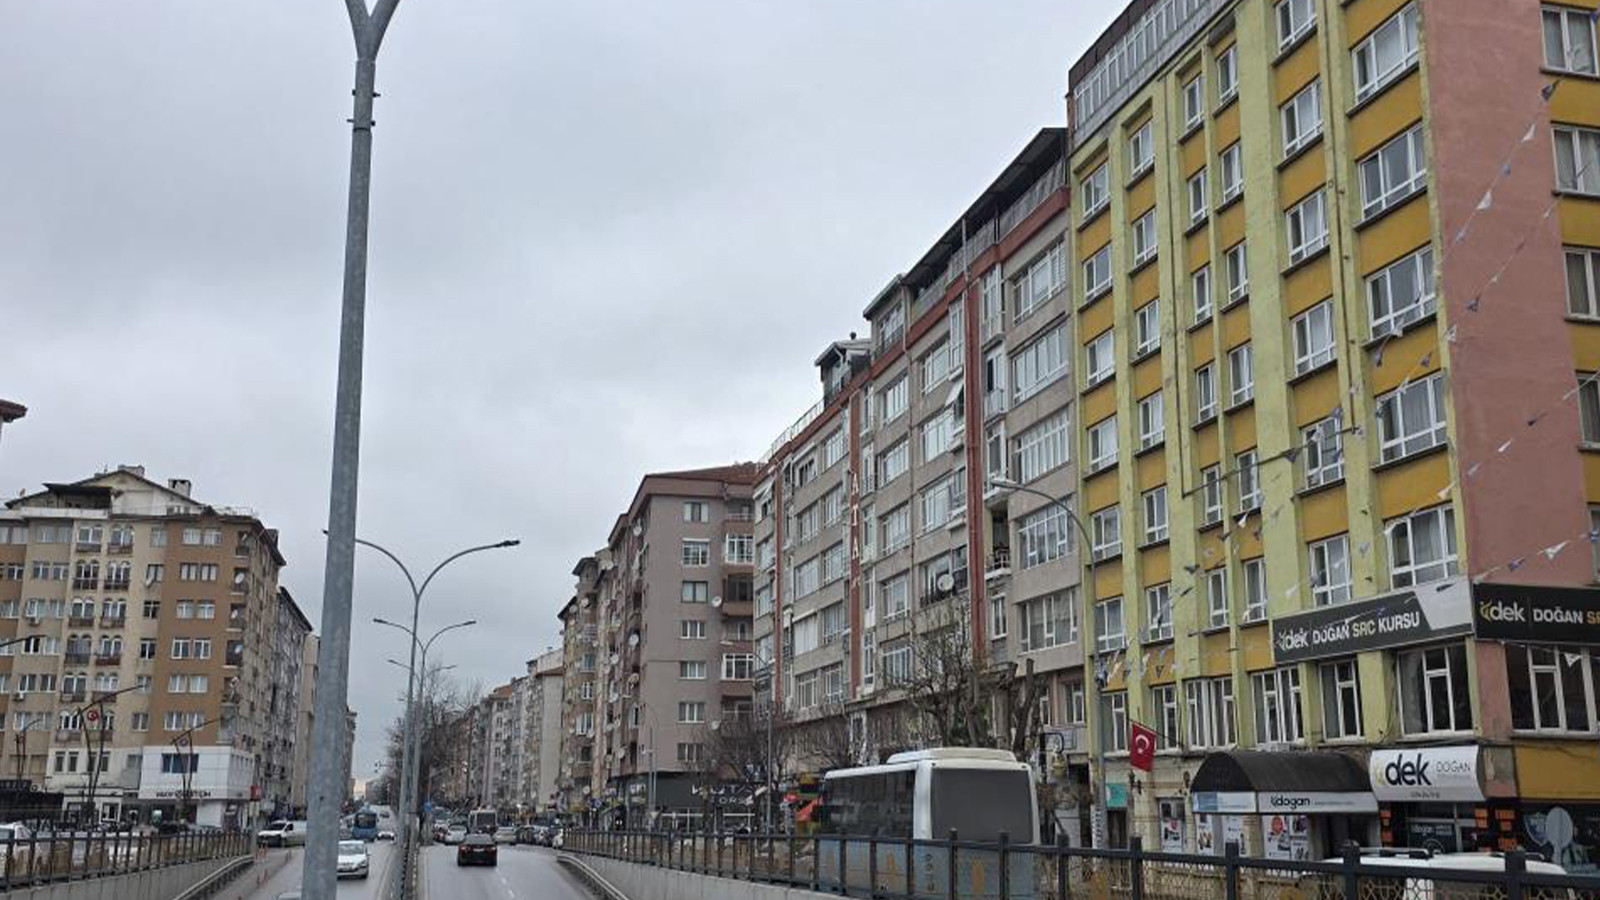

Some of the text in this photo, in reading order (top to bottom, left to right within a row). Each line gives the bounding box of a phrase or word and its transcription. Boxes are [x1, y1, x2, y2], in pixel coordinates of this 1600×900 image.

[1352, 620, 1376, 638] SRC
[1378, 611, 1420, 634] KURSU
[1533, 606, 1584, 625] DOĞAN
